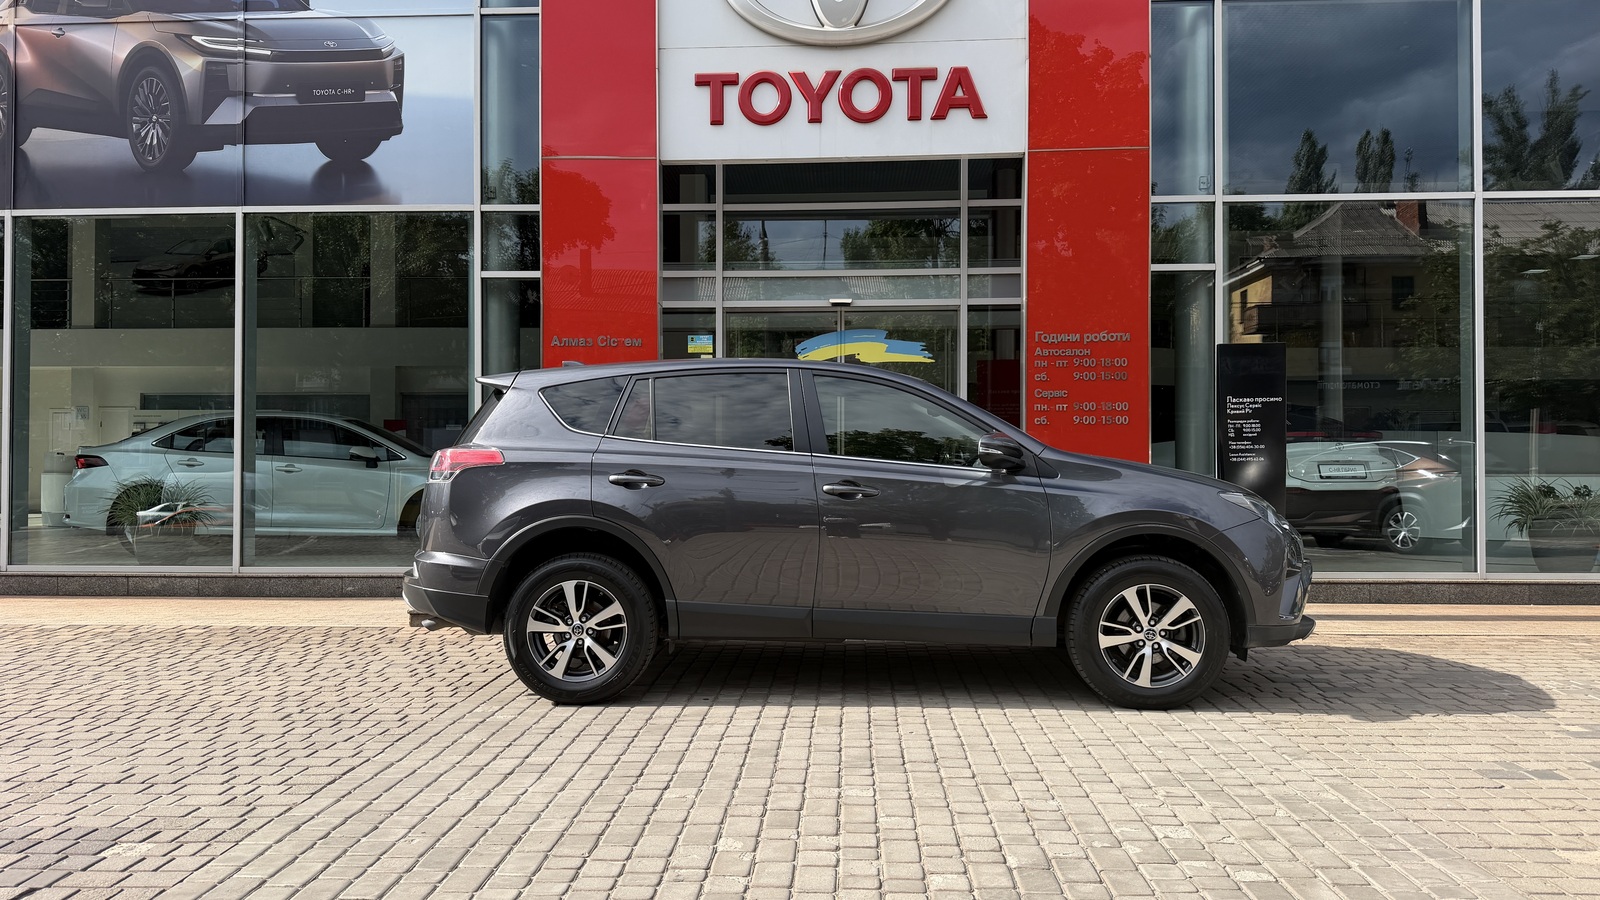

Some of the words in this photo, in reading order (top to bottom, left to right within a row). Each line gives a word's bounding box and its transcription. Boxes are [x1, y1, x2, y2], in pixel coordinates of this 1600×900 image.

[694, 66, 988, 126] TOYOTA
[550, 335, 593, 347] Алмаз
[1034, 331, 1080, 344] Години
[1083, 330, 1131, 344] роботи
[1034, 347, 1091, 356] Автосалон
[1034, 372, 1050, 381] сб.
[1034, 388, 1068, 399] Сервіс
[1034, 416, 1050, 425] сб.
